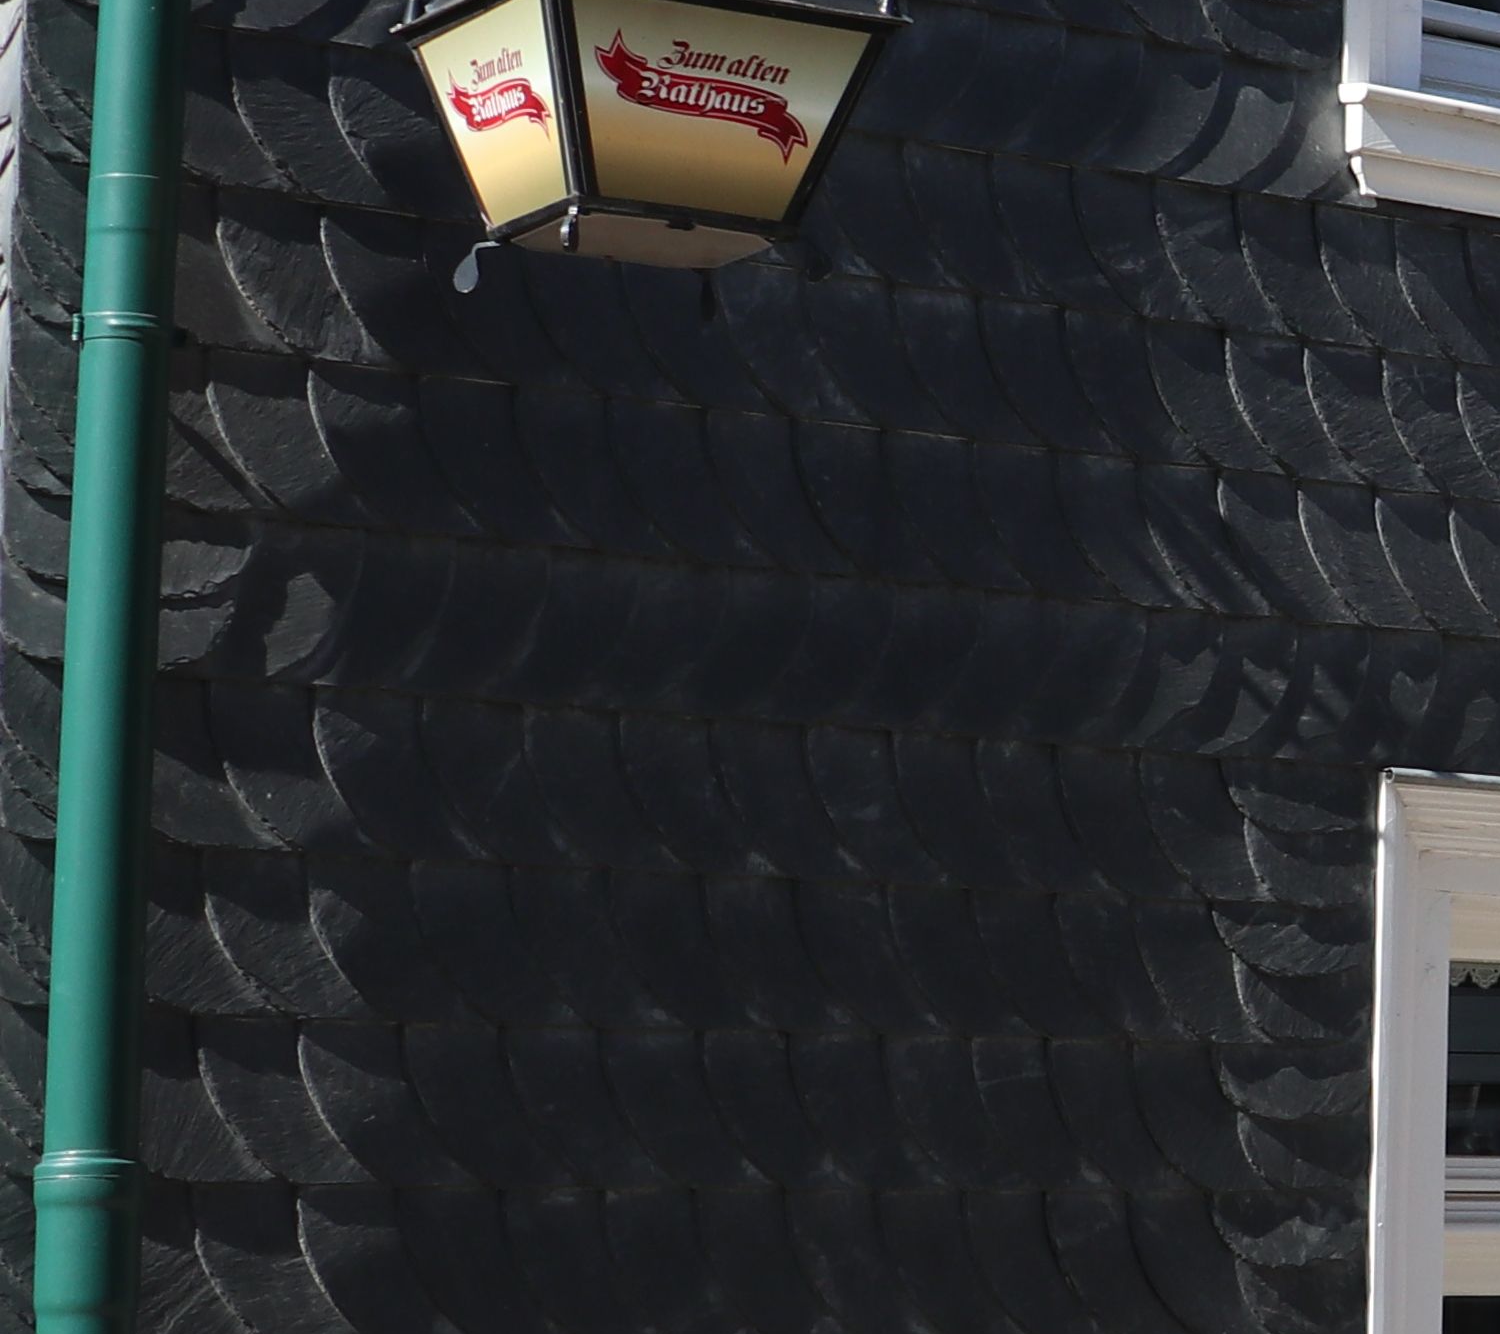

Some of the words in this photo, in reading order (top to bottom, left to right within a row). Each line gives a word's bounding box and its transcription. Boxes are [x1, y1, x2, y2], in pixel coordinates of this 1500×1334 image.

[469, 59, 496, 91] Zum
[657, 38, 727, 72] Zum
[728, 54, 790, 85] alten
[470, 86, 526, 123] Rathaus
[635, 70, 766, 115] Rathaus
